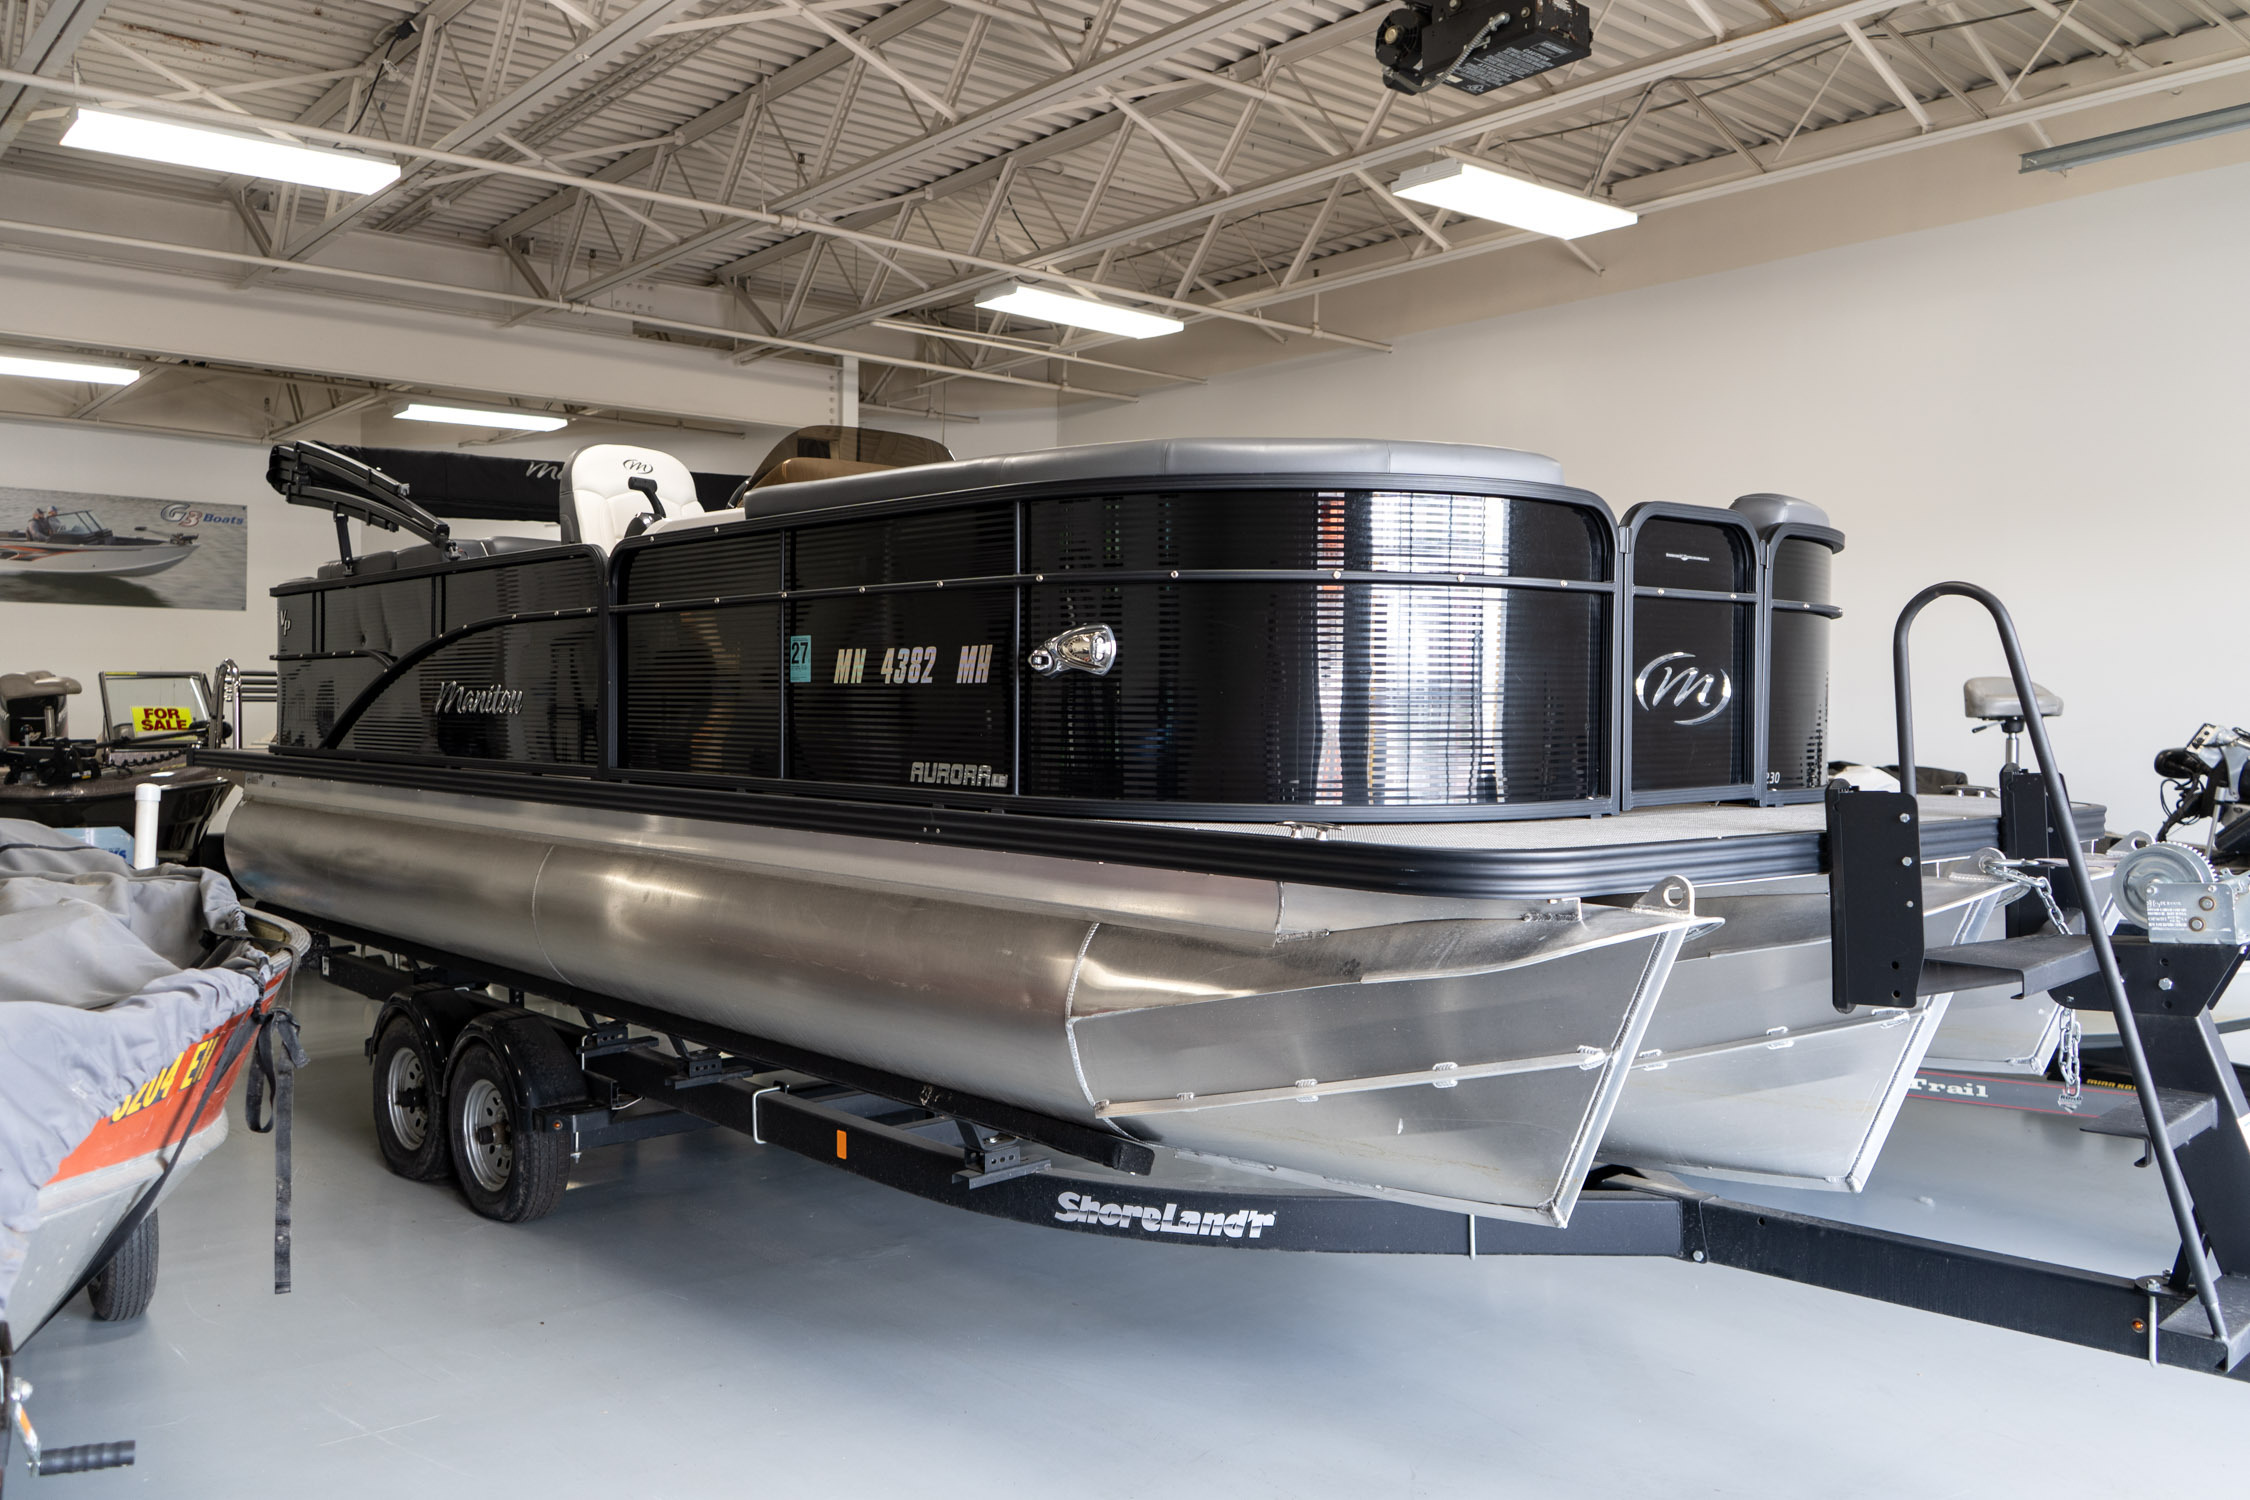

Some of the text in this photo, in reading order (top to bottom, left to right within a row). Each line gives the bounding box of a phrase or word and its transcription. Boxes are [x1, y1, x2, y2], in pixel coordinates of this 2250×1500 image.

[203, 513, 244, 525] Boats
[792, 641, 808, 664] 27
[833, 644, 993, 684] MN 4382 MH
[435, 681, 523, 714] Manitou
[143, 707, 180, 719] FOR
[141, 719, 190, 731] SALE
[910, 761, 1009, 788] AURORA LE
[1910, 1078, 1989, 1098] Trail
[1055, 1191, 1277, 1239] ShoreLand'r
